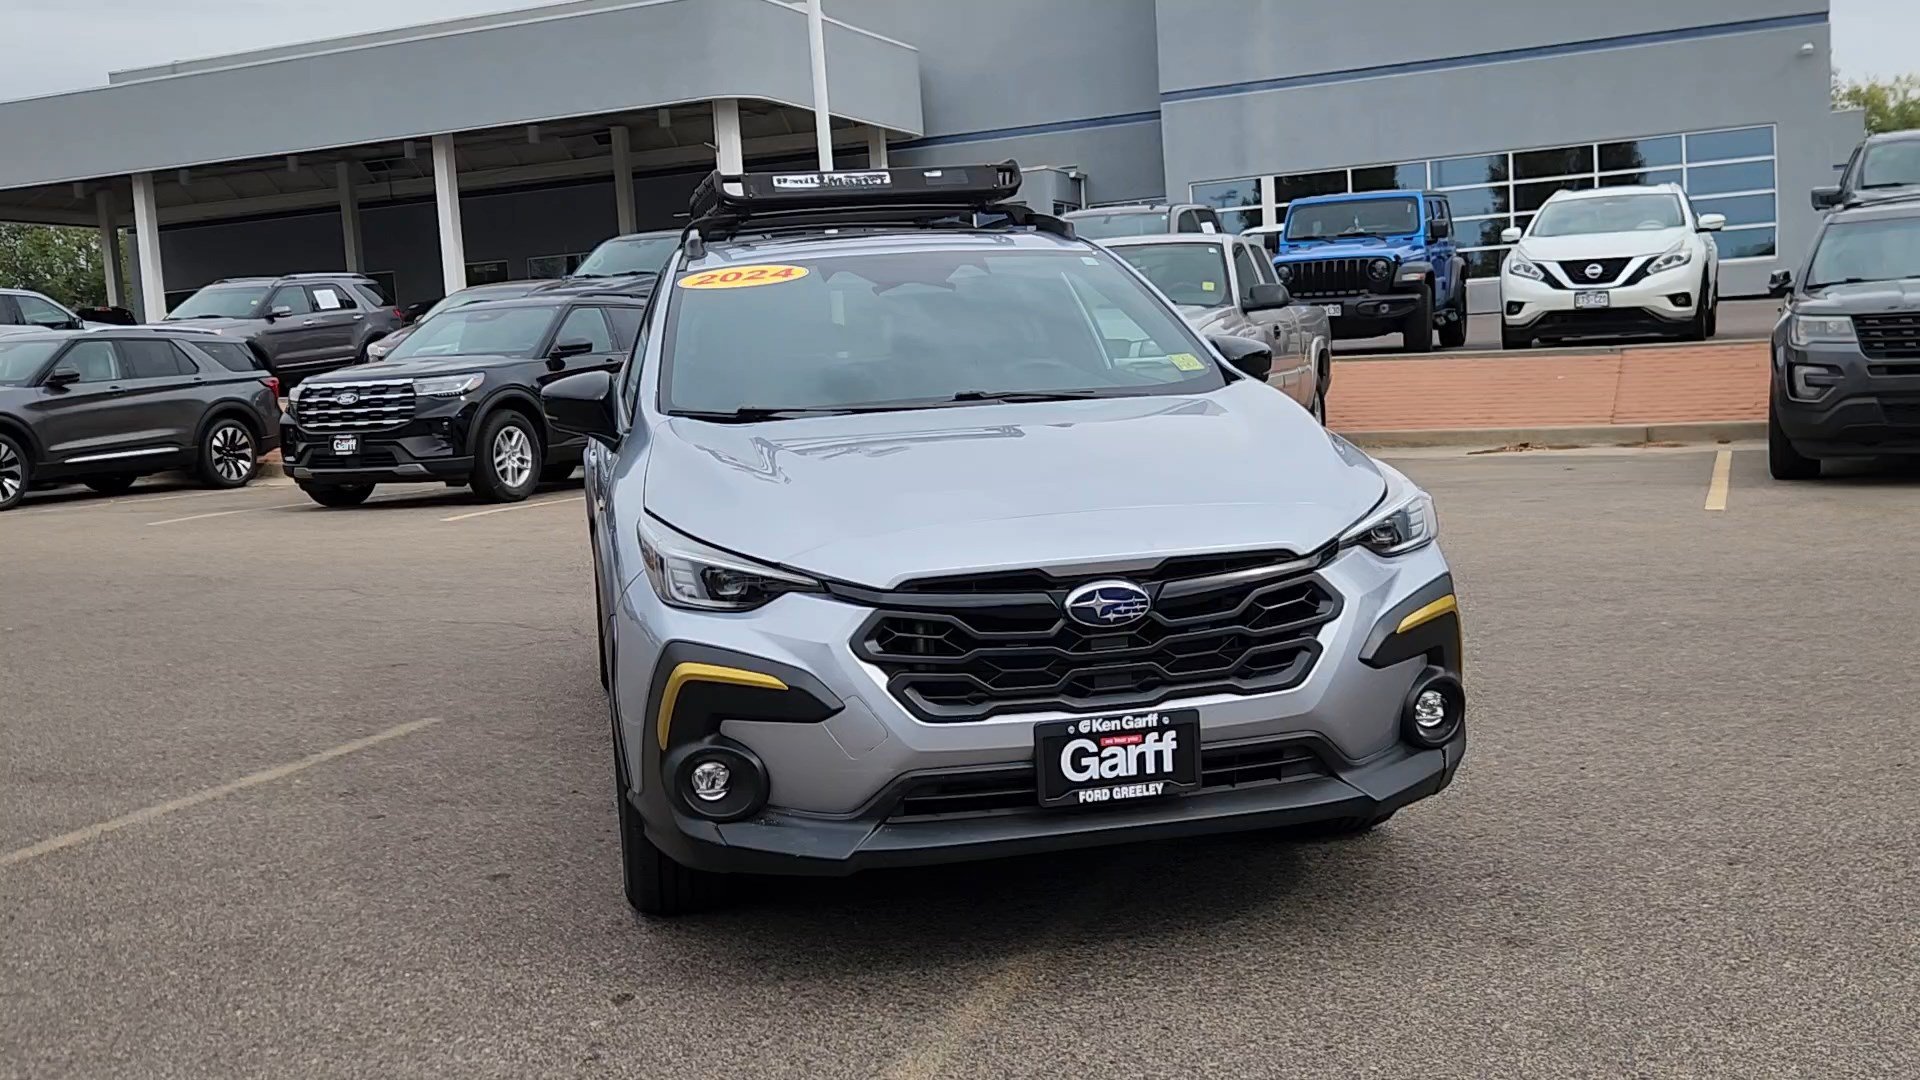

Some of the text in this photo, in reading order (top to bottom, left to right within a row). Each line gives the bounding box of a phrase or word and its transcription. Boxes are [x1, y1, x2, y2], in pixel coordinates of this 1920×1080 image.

[696, 266, 796, 286] 2024
[333, 438, 357, 451] Garff
[1092, 713, 1159, 733] Ken Garff
[1060, 730, 1177, 782] Garff
[1079, 782, 1164, 804] FORD GREELEY
